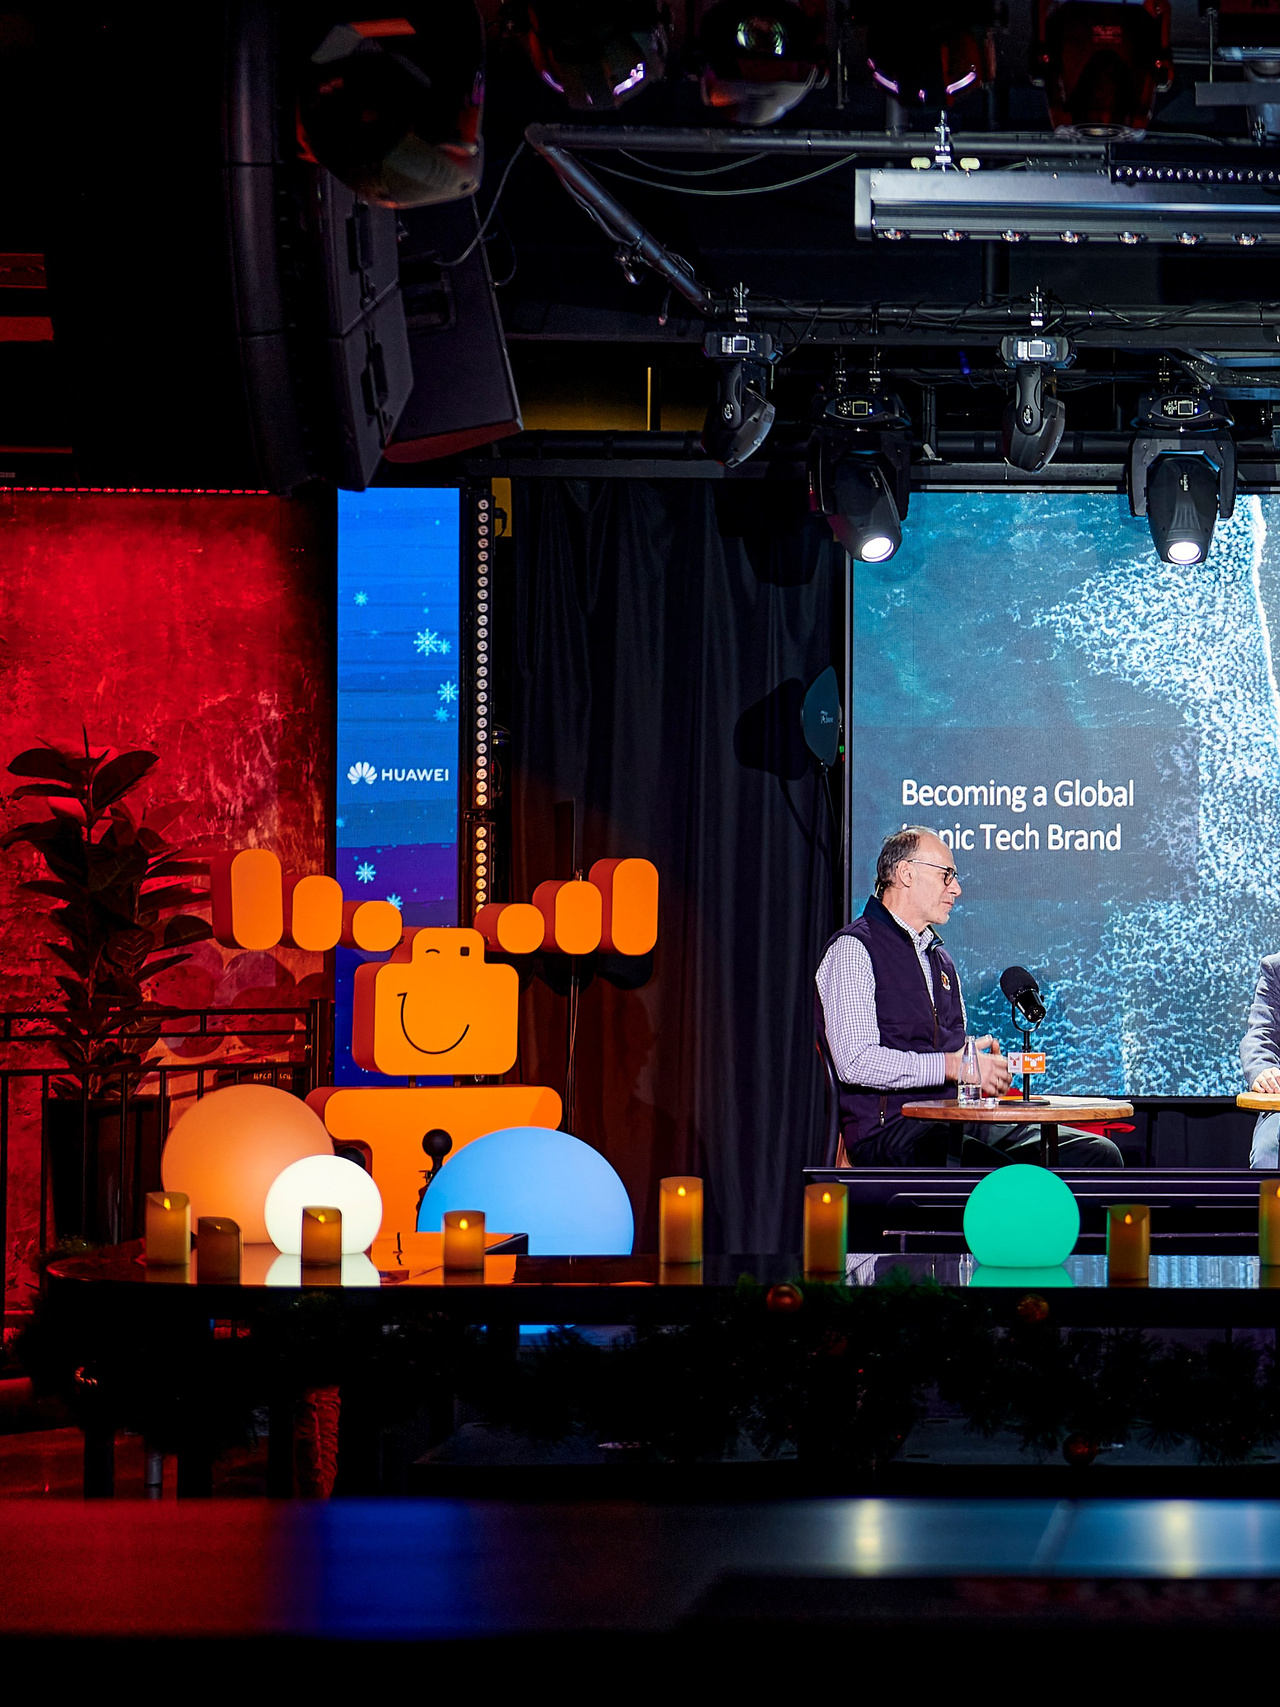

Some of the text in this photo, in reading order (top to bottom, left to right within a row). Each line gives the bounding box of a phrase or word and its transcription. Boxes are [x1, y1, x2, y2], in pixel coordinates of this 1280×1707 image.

[381, 768, 449, 782] HUAWEI
[902, 779, 1135, 813] Becoming a Global
[979, 823, 1040, 851] Tech
[1047, 823, 1122, 851] Brand
